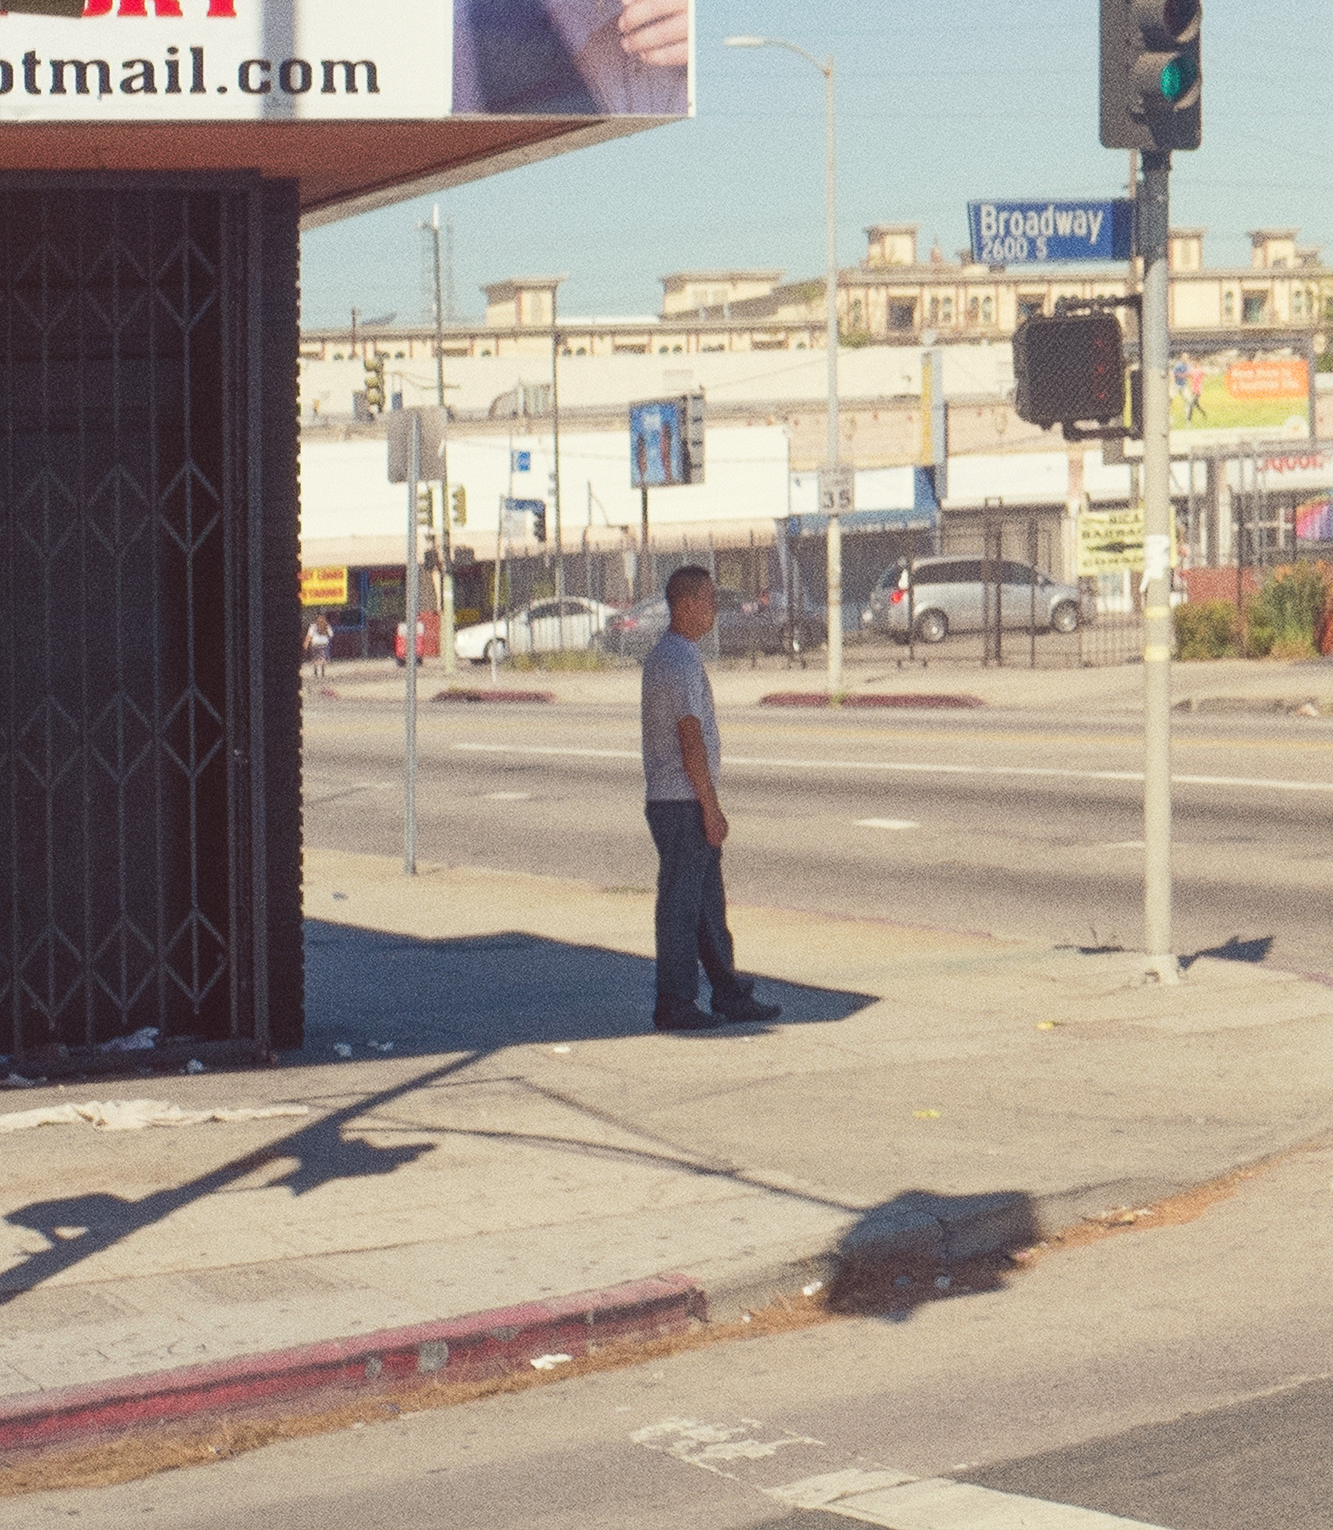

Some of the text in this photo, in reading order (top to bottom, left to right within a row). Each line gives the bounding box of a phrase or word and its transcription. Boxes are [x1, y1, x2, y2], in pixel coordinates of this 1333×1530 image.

[980, 203, 1103, 246] Broadway
[981, 236, 1048, 262] 2600 S
